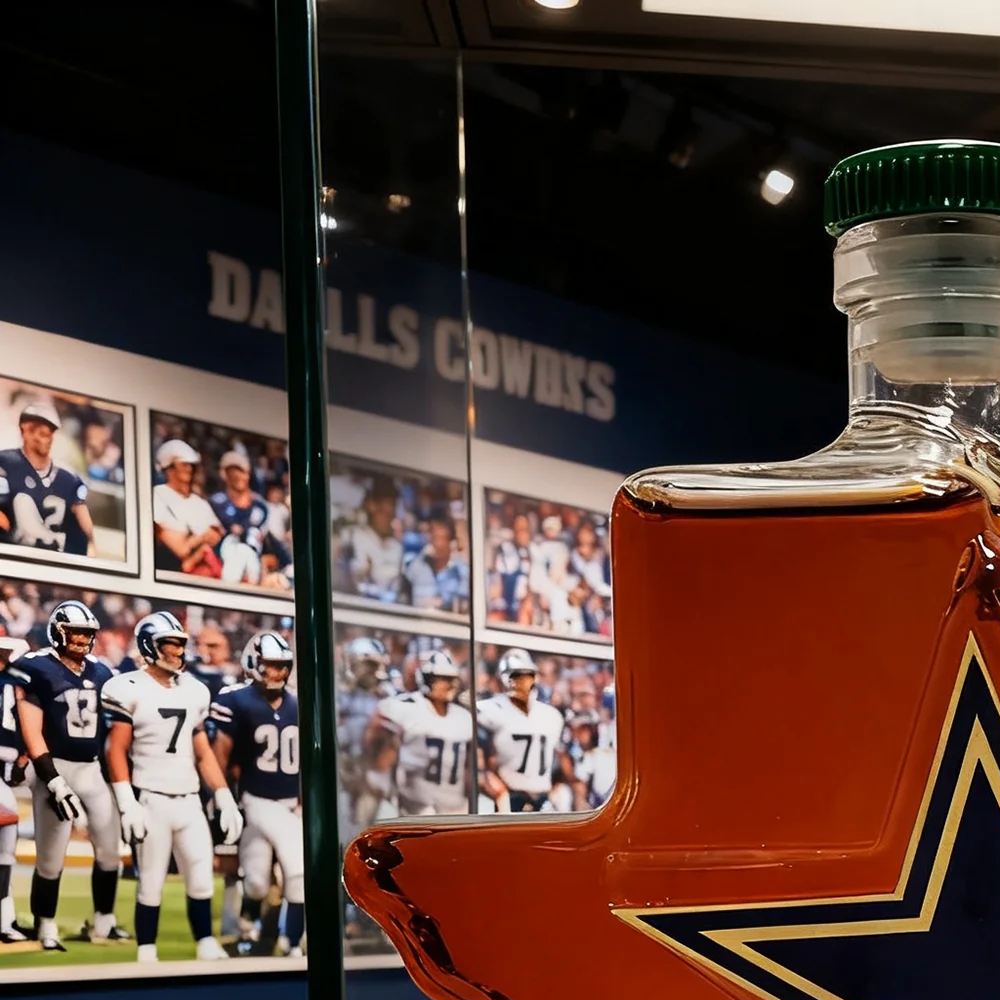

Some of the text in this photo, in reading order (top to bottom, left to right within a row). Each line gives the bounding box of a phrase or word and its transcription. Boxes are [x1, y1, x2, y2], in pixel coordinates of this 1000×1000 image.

[158, 708, 186, 754] 7
[254, 723, 299, 775] 20
[512, 734, 547, 776] 71
